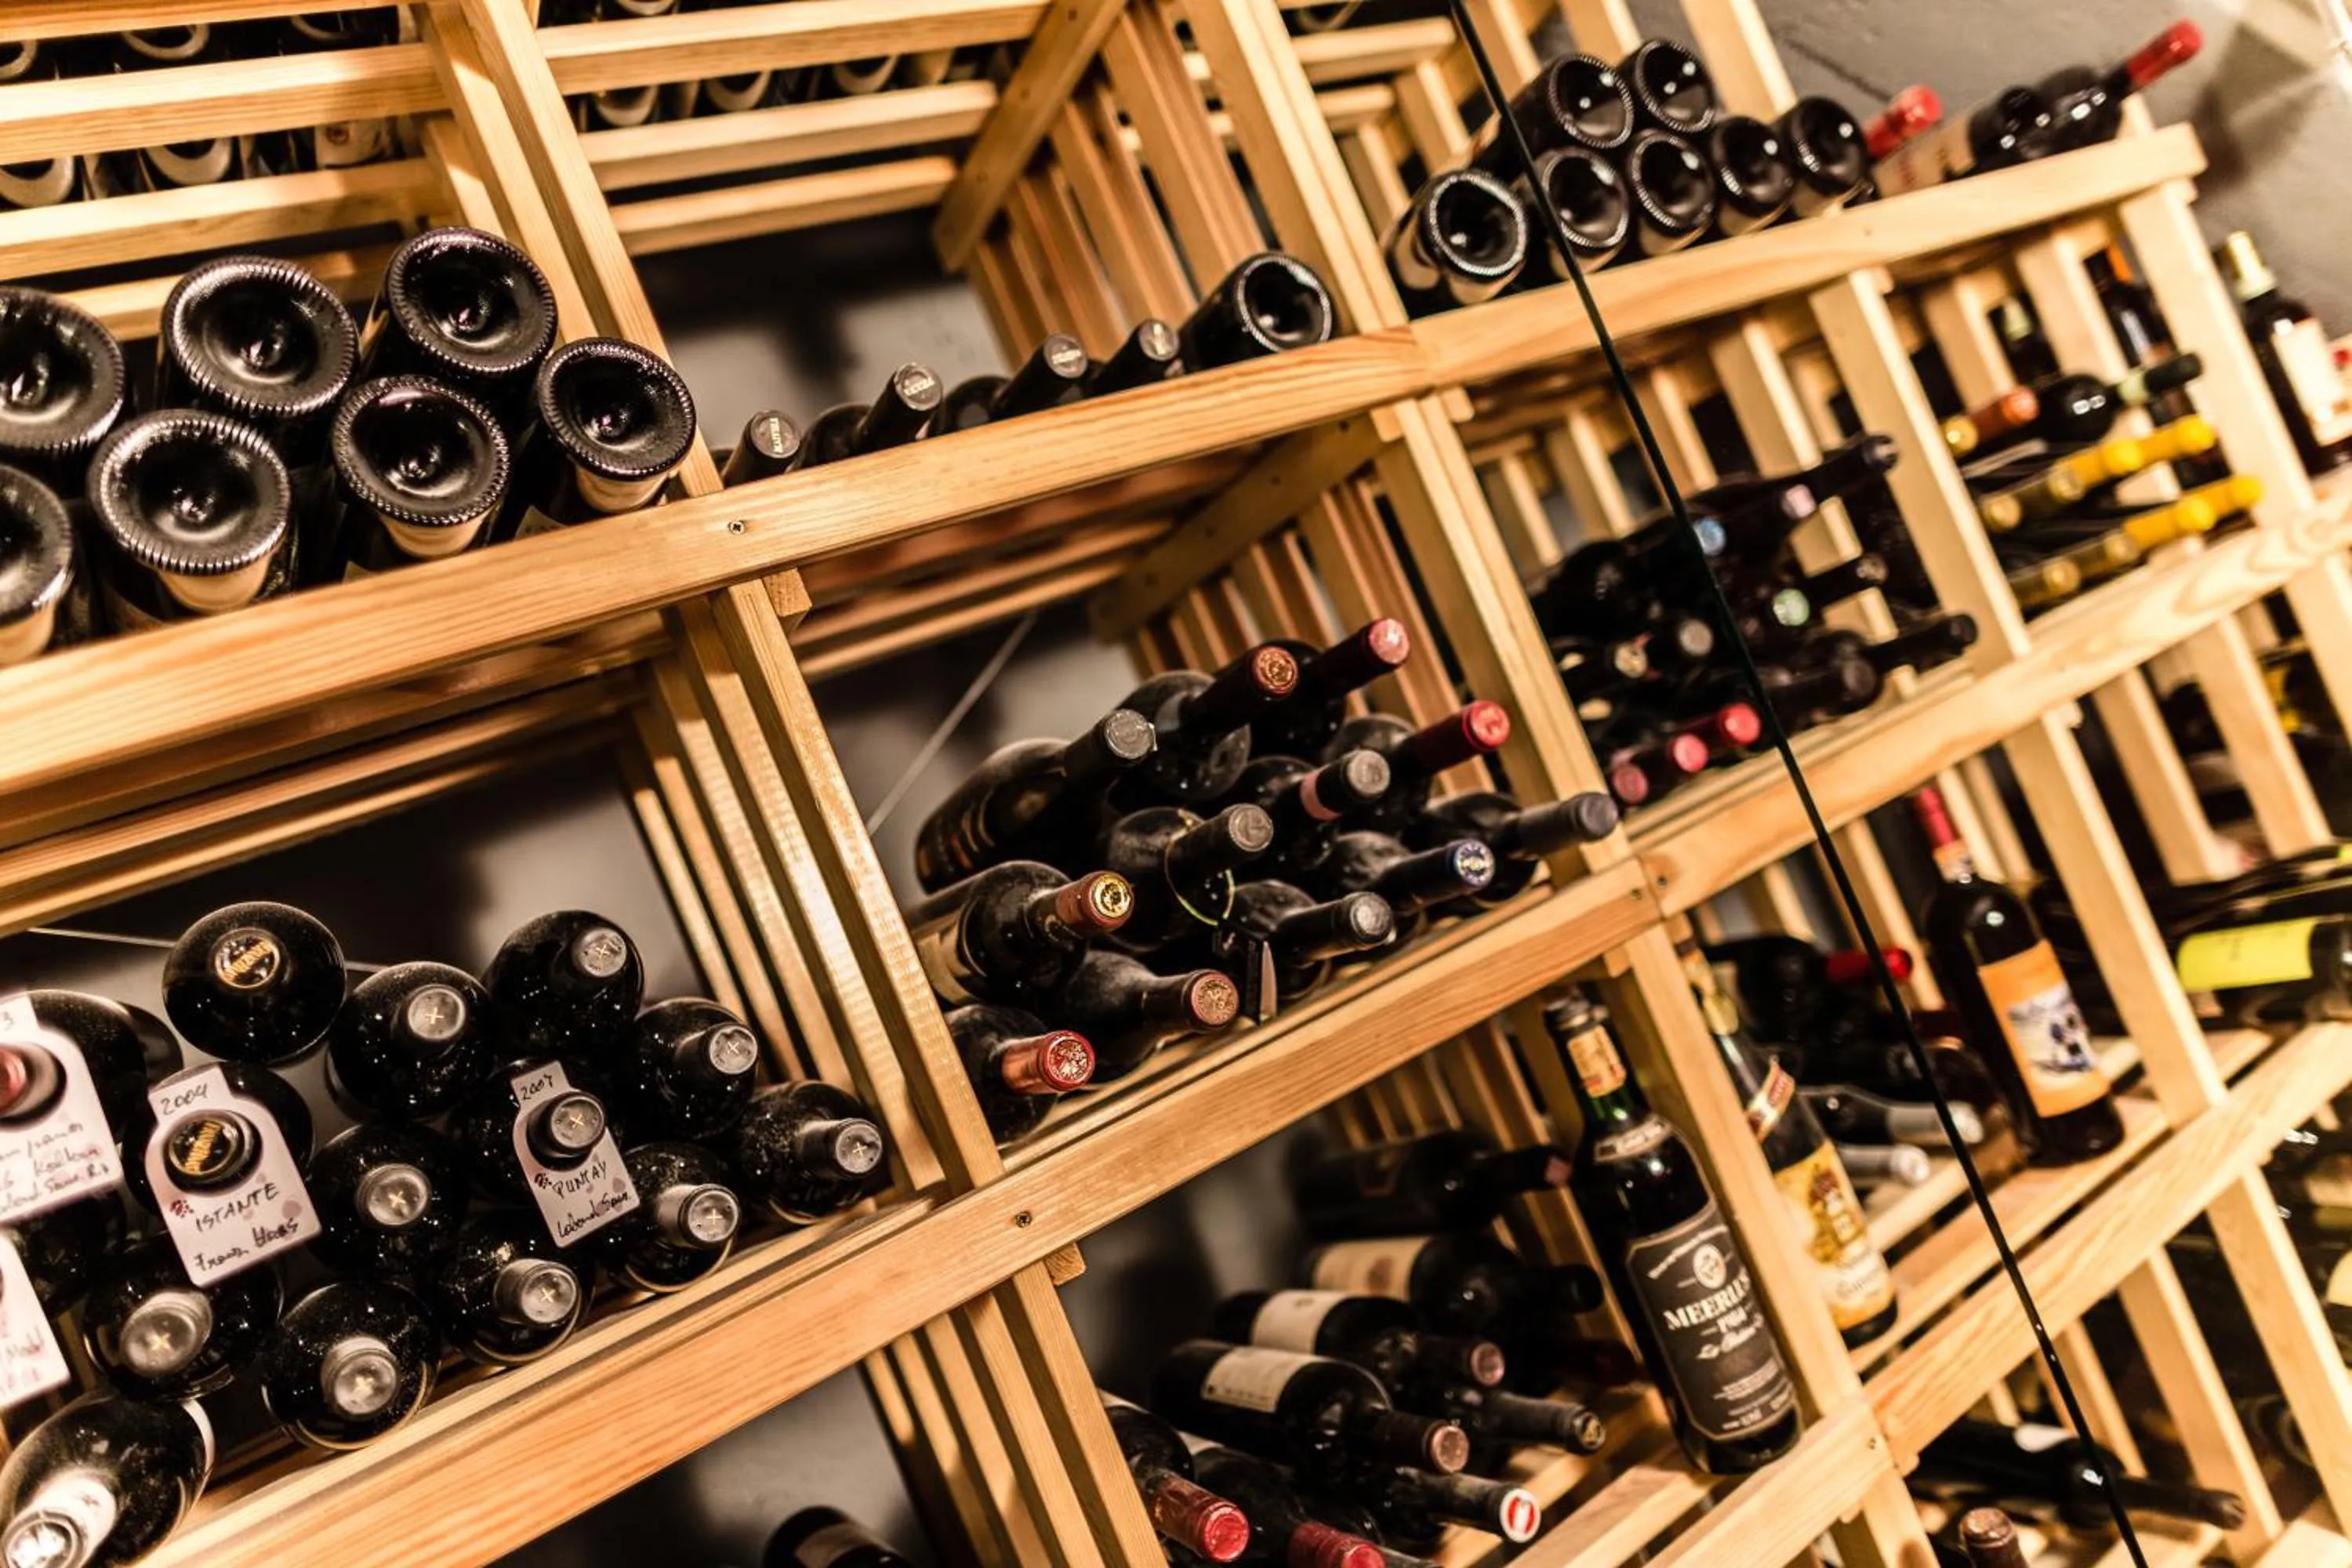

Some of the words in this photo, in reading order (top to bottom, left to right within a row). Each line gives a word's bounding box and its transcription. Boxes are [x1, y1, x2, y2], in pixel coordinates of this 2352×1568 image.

[160, 1083, 209, 1116] 2004
[519, 1073, 554, 1101] 2007
[196, 1181, 280, 1232] ISTANTE
